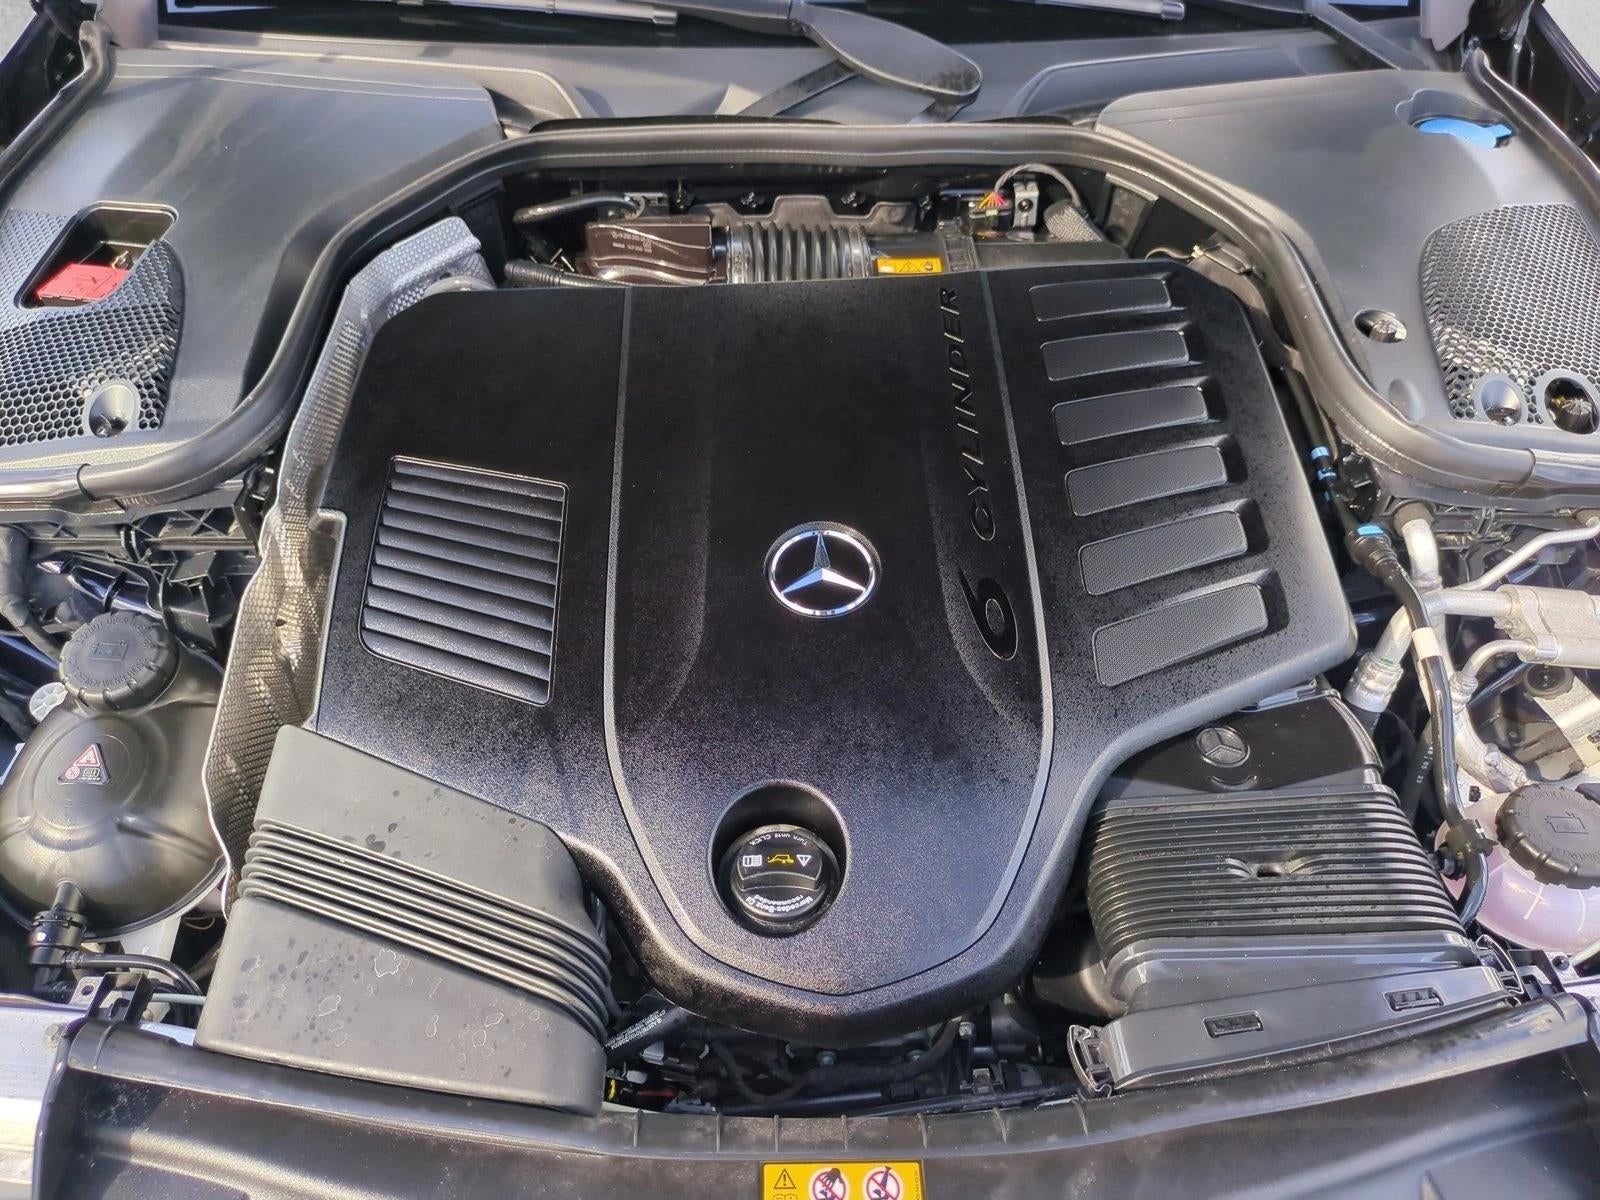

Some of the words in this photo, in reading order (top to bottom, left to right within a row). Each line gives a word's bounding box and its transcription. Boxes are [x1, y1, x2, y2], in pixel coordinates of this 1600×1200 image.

[938, 287, 997, 541] CYLINDER
[957, 565, 1018, 661] 6
[749, 833, 771, 846] CLICK
